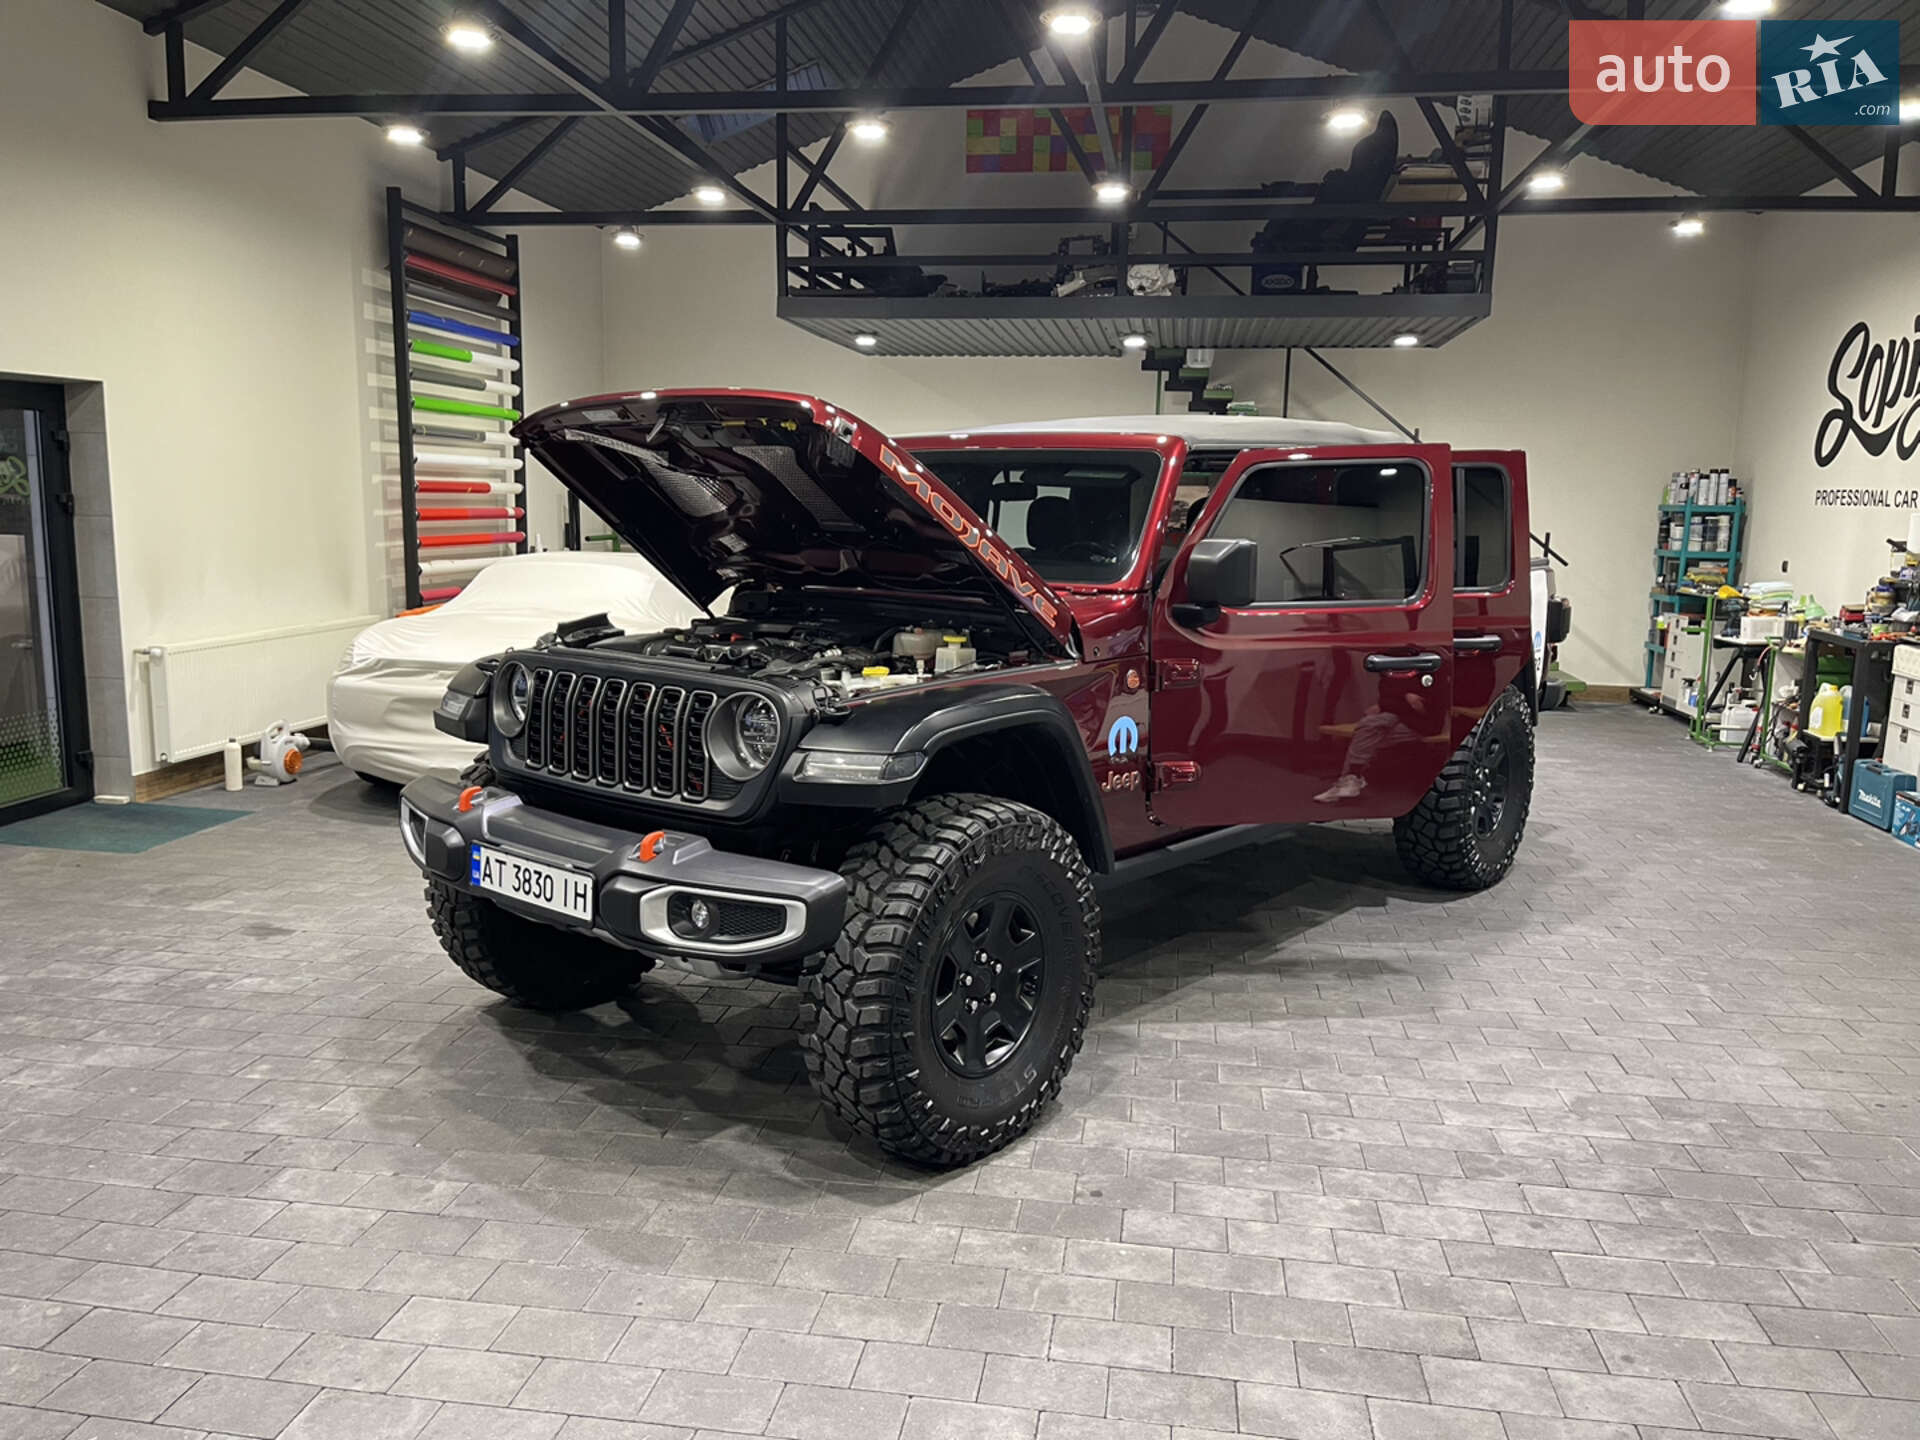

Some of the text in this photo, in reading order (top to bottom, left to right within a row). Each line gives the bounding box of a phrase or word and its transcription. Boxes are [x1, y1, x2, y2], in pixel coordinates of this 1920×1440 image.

[1815, 490, 1918, 509] PROFESSIONAL CAR
[879, 444, 1058, 628] MOJAVE
[1101, 770, 1140, 793] Jeep
[482, 856, 588, 913] AT 3830 IH
